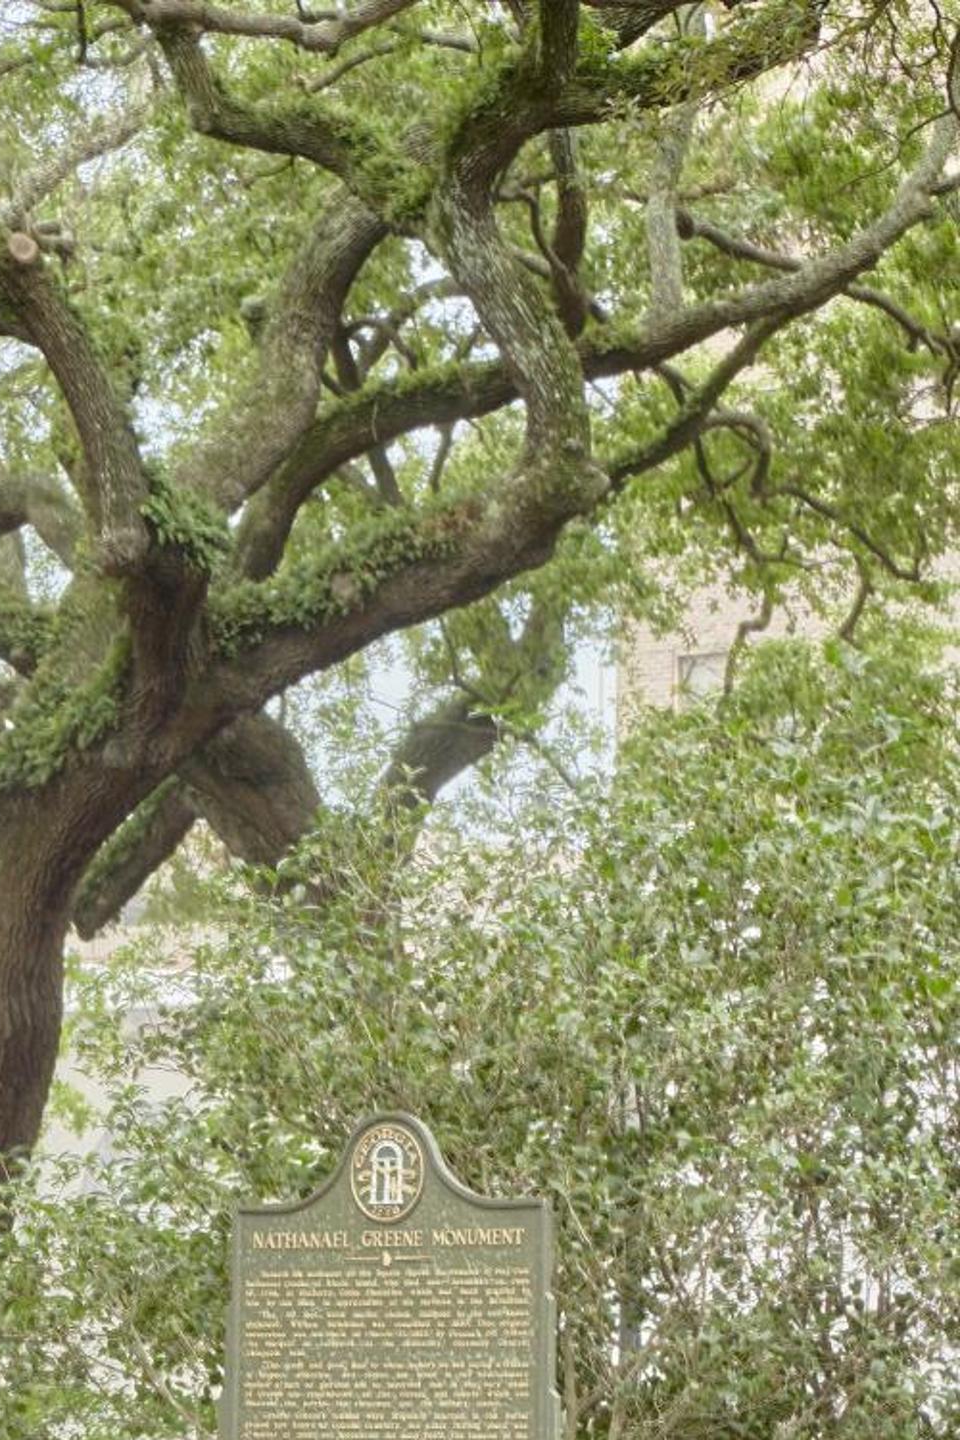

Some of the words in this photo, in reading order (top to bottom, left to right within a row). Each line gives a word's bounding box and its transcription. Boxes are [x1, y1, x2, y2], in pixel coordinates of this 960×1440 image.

[252, 1231, 350, 1249] NATHANAEL
[361, 1230, 424, 1247] GREENE
[431, 1227, 526, 1247] MONUMENT
